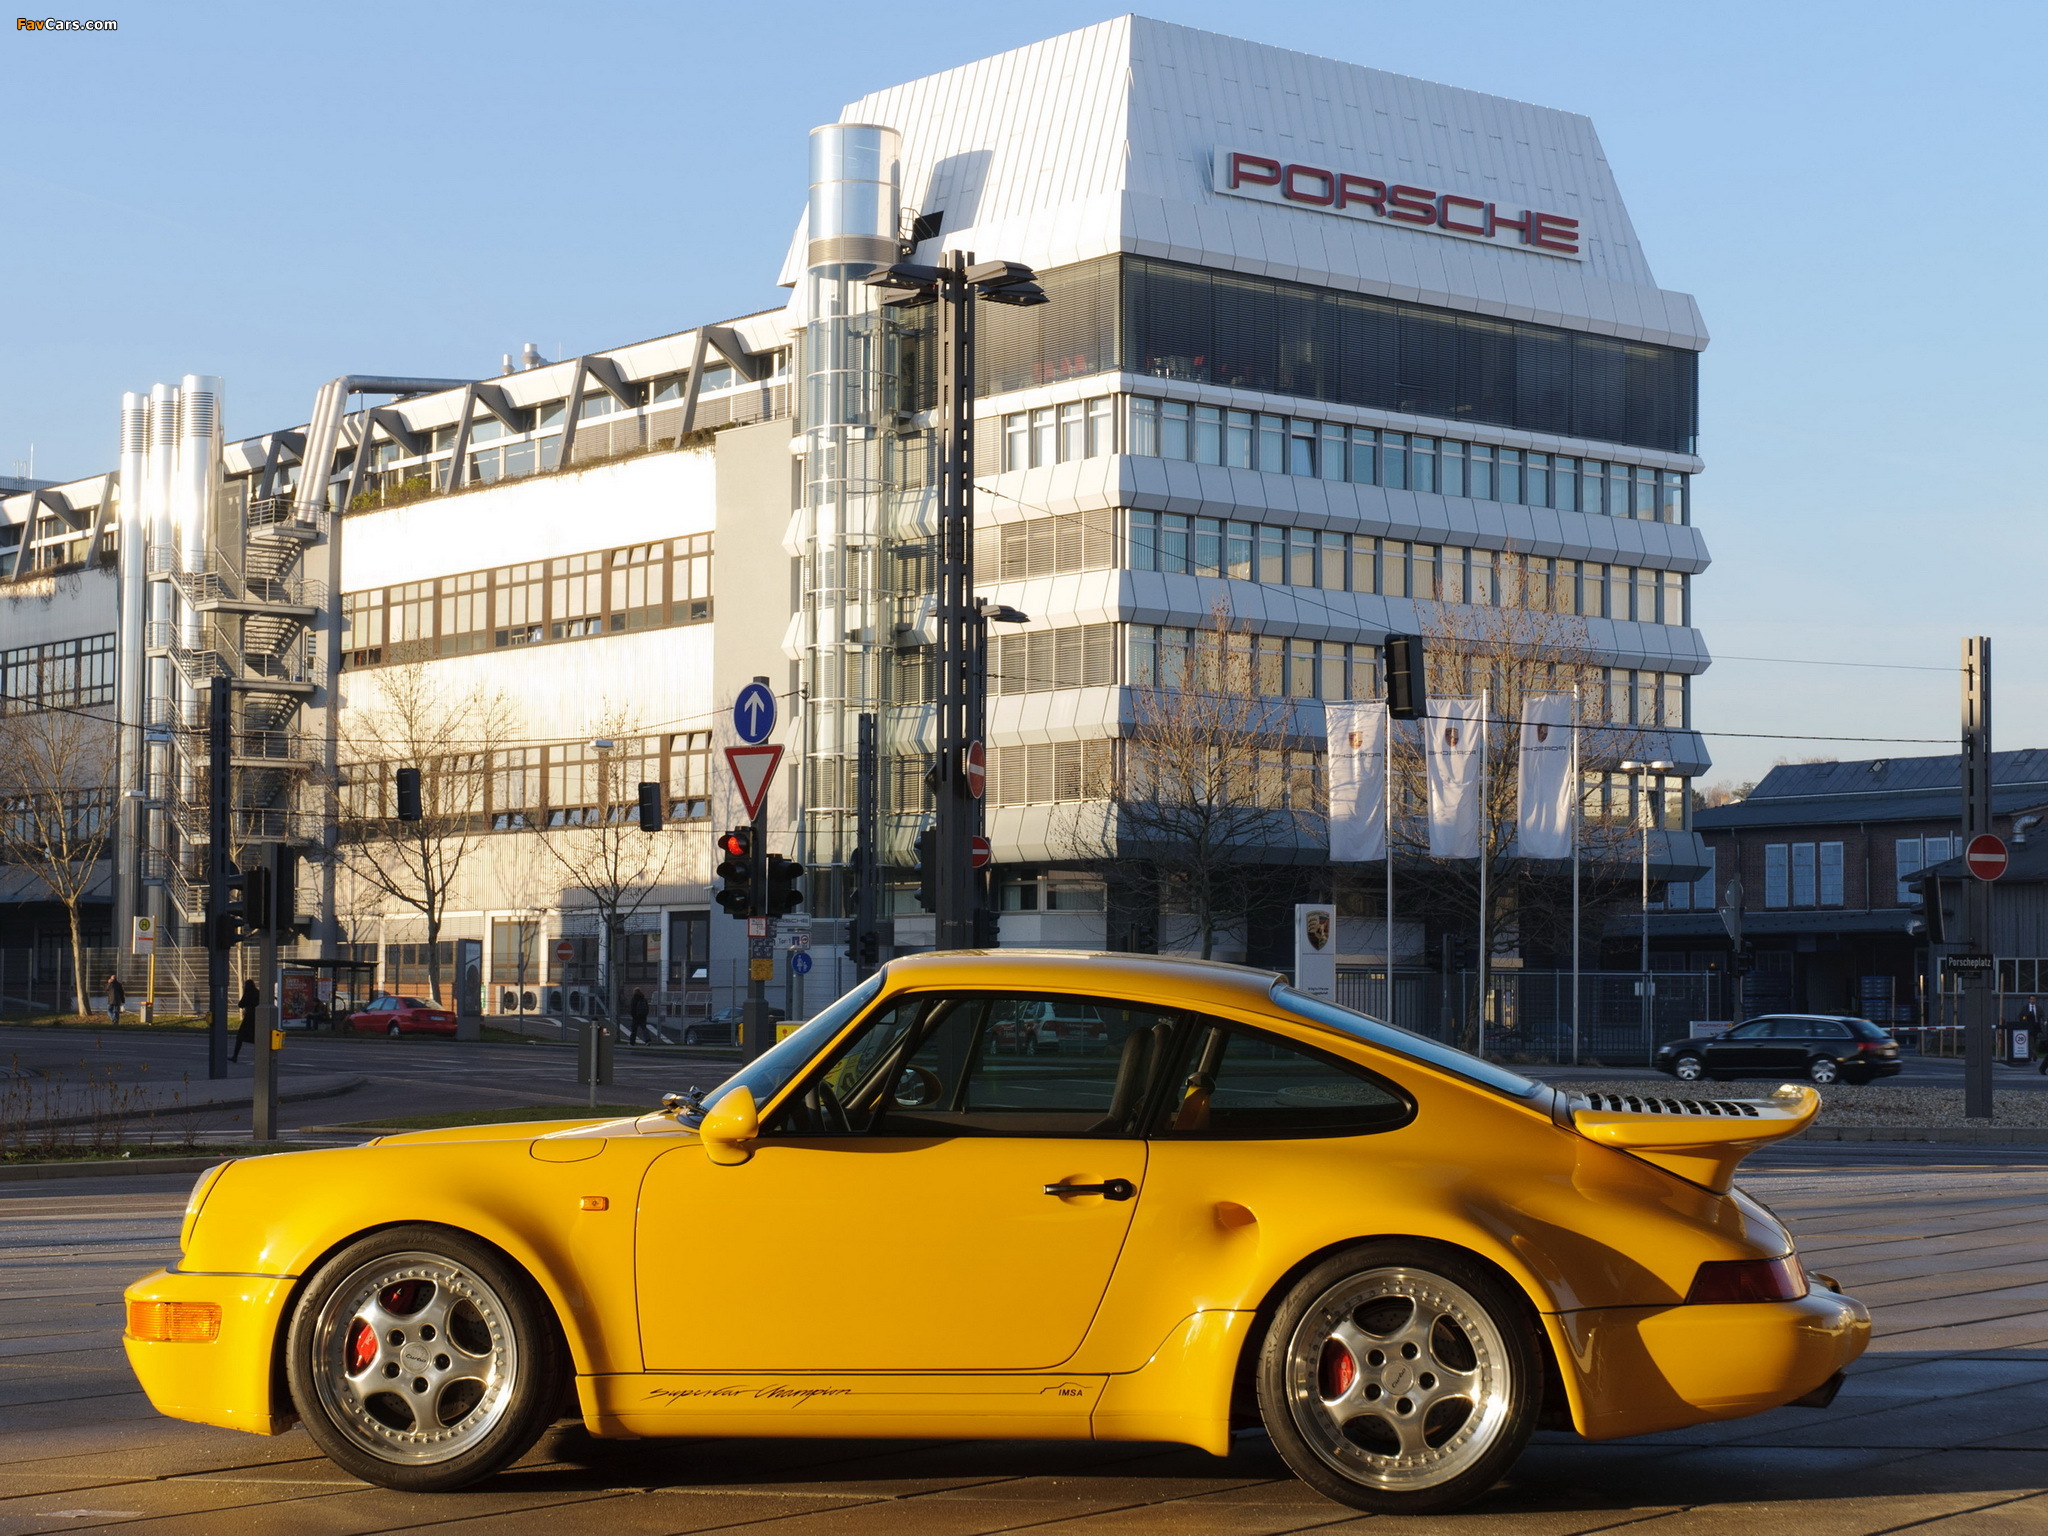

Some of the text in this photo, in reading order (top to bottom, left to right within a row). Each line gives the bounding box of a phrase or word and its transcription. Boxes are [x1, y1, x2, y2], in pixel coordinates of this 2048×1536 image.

[1229, 152, 1579, 254] PORSCHE
[1948, 957, 1991, 968] Porscheplatz
[1058, 1388, 1083, 1397] IMSA
